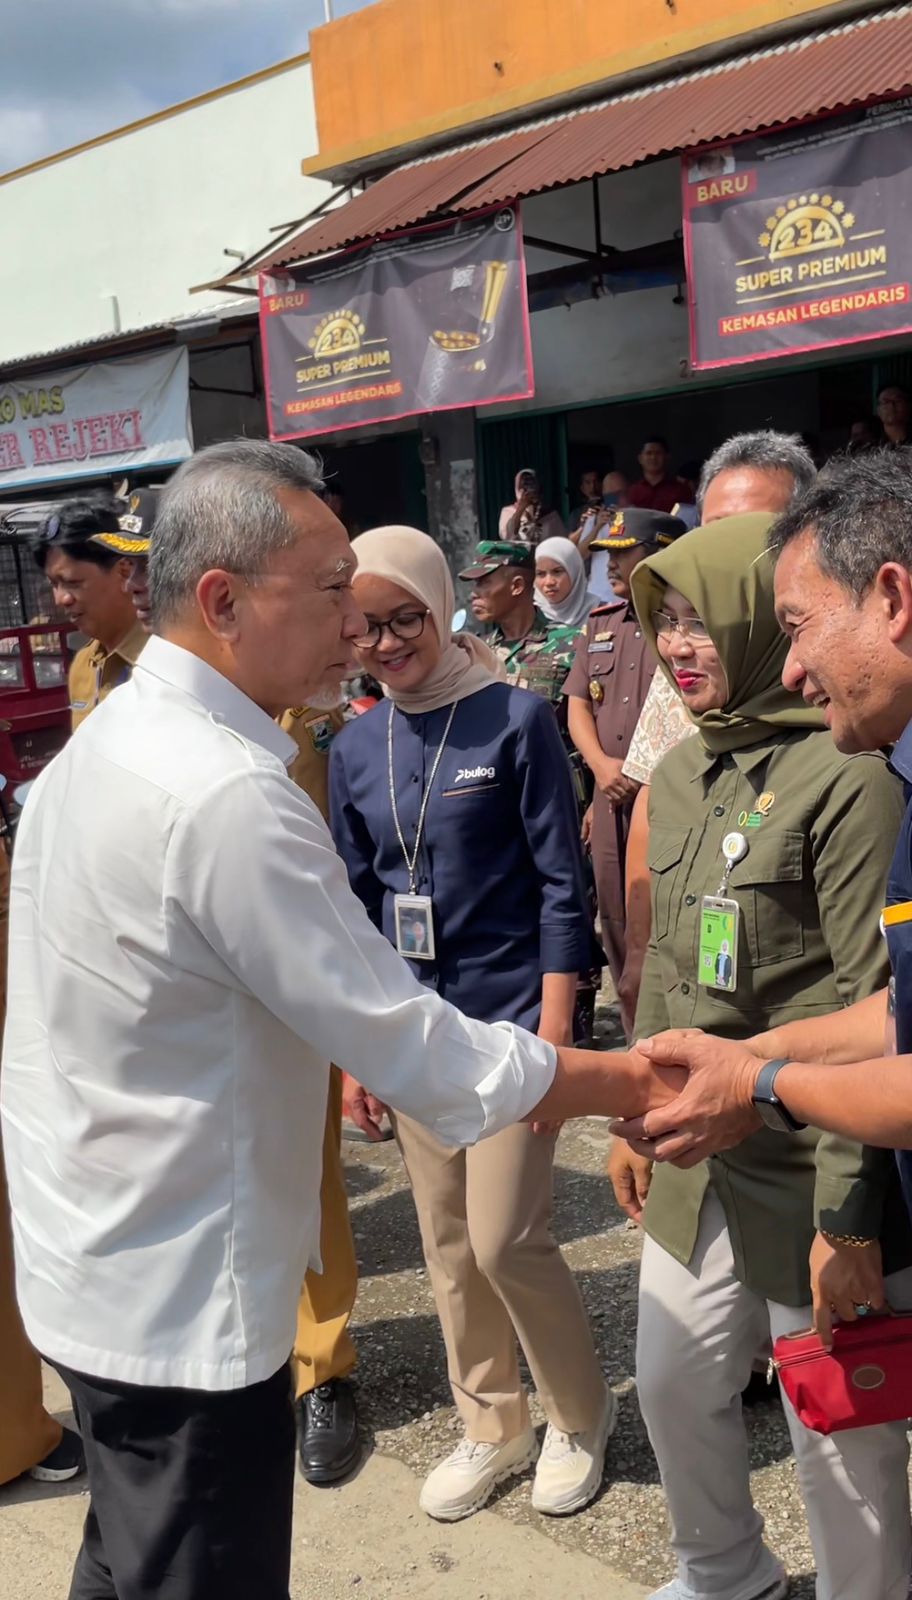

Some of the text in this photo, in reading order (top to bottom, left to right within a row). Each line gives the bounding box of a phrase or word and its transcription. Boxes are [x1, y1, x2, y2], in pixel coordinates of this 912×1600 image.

[697, 175, 748, 202] BARU
[778, 218, 833, 250] 234
[735, 246, 887, 293] SUPER PREMIUM
[269, 294, 304, 312] BARU
[722, 286, 905, 333] KEMASAN LEGENDARIS
[320, 328, 355, 351] 234
[296, 350, 391, 383] SUPER PREMIUM
[18, 385, 65, 419] MAS
[287, 396, 334, 414] KEMASAN
[29, 409, 146, 467] REJEKI
[464, 765, 496, 779] bulog
